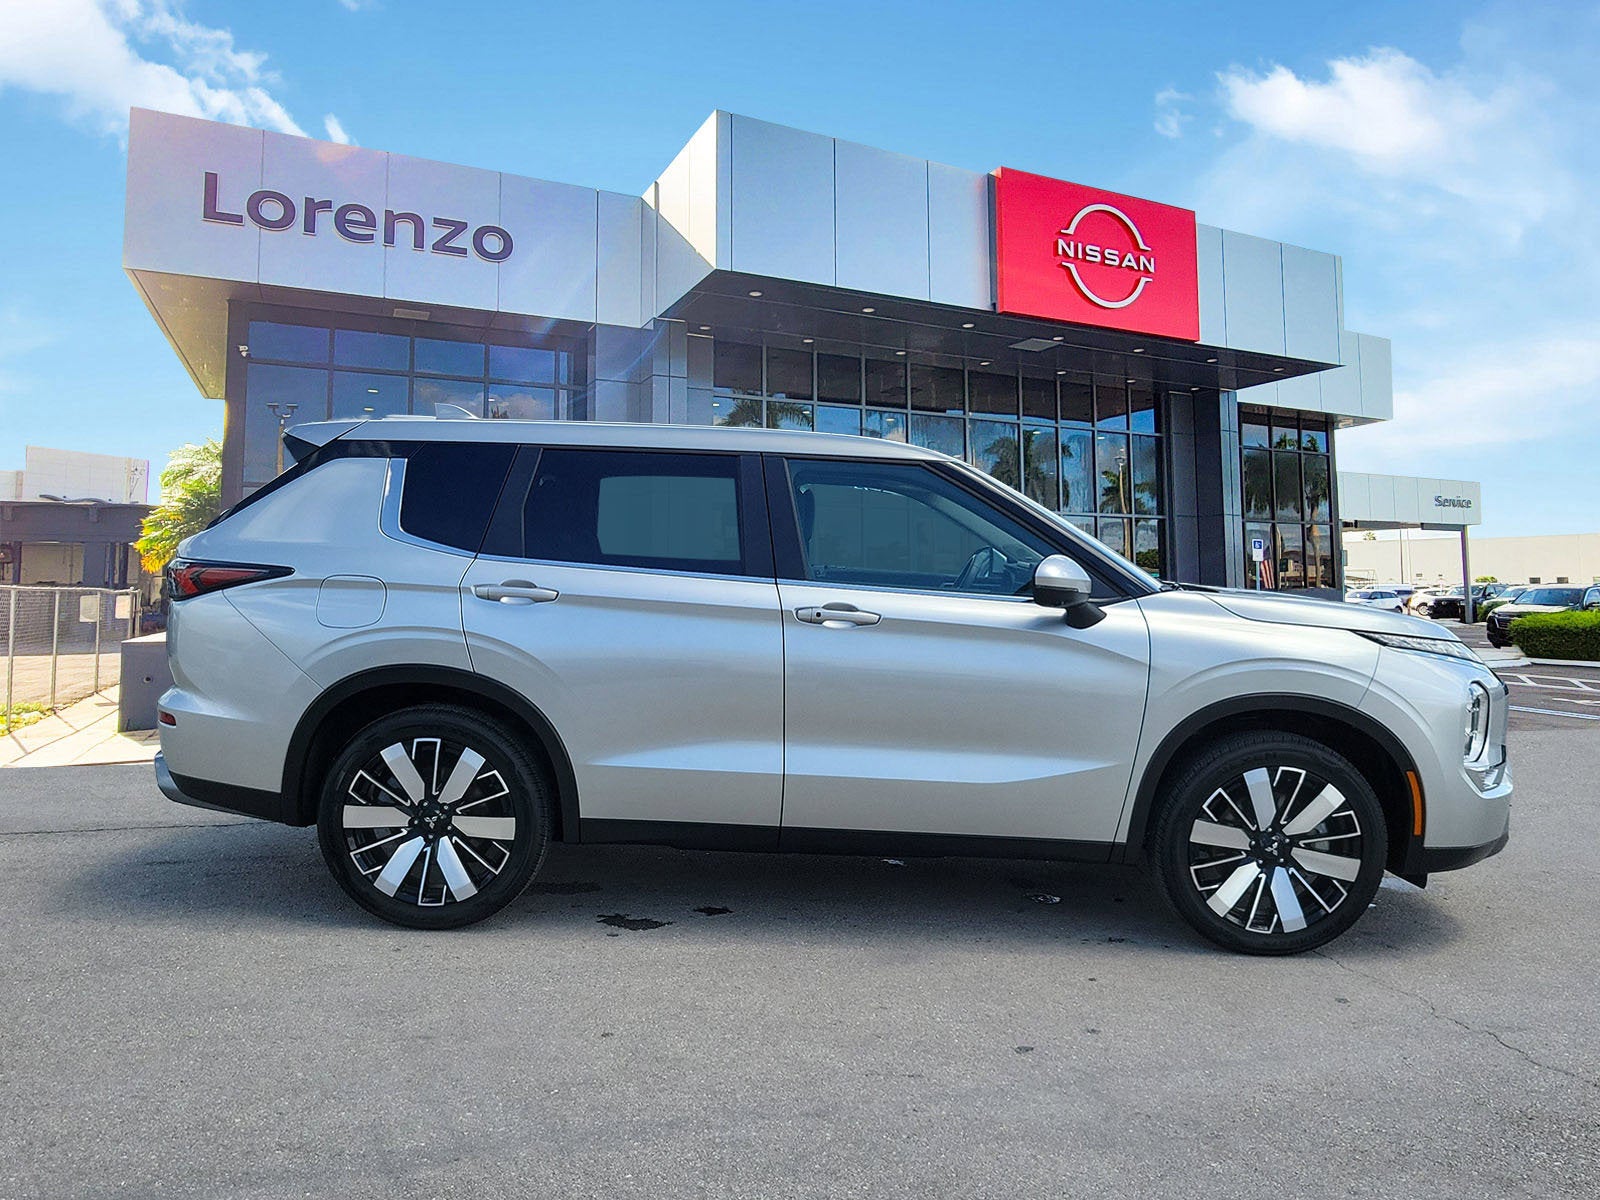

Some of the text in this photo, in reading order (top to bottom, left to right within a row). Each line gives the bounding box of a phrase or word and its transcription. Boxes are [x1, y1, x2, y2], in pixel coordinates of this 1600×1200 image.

[202, 171, 514, 262] Lorenzo
[1057, 238, 1155, 273] NISSAN
[1434, 495, 1472, 509] Service
